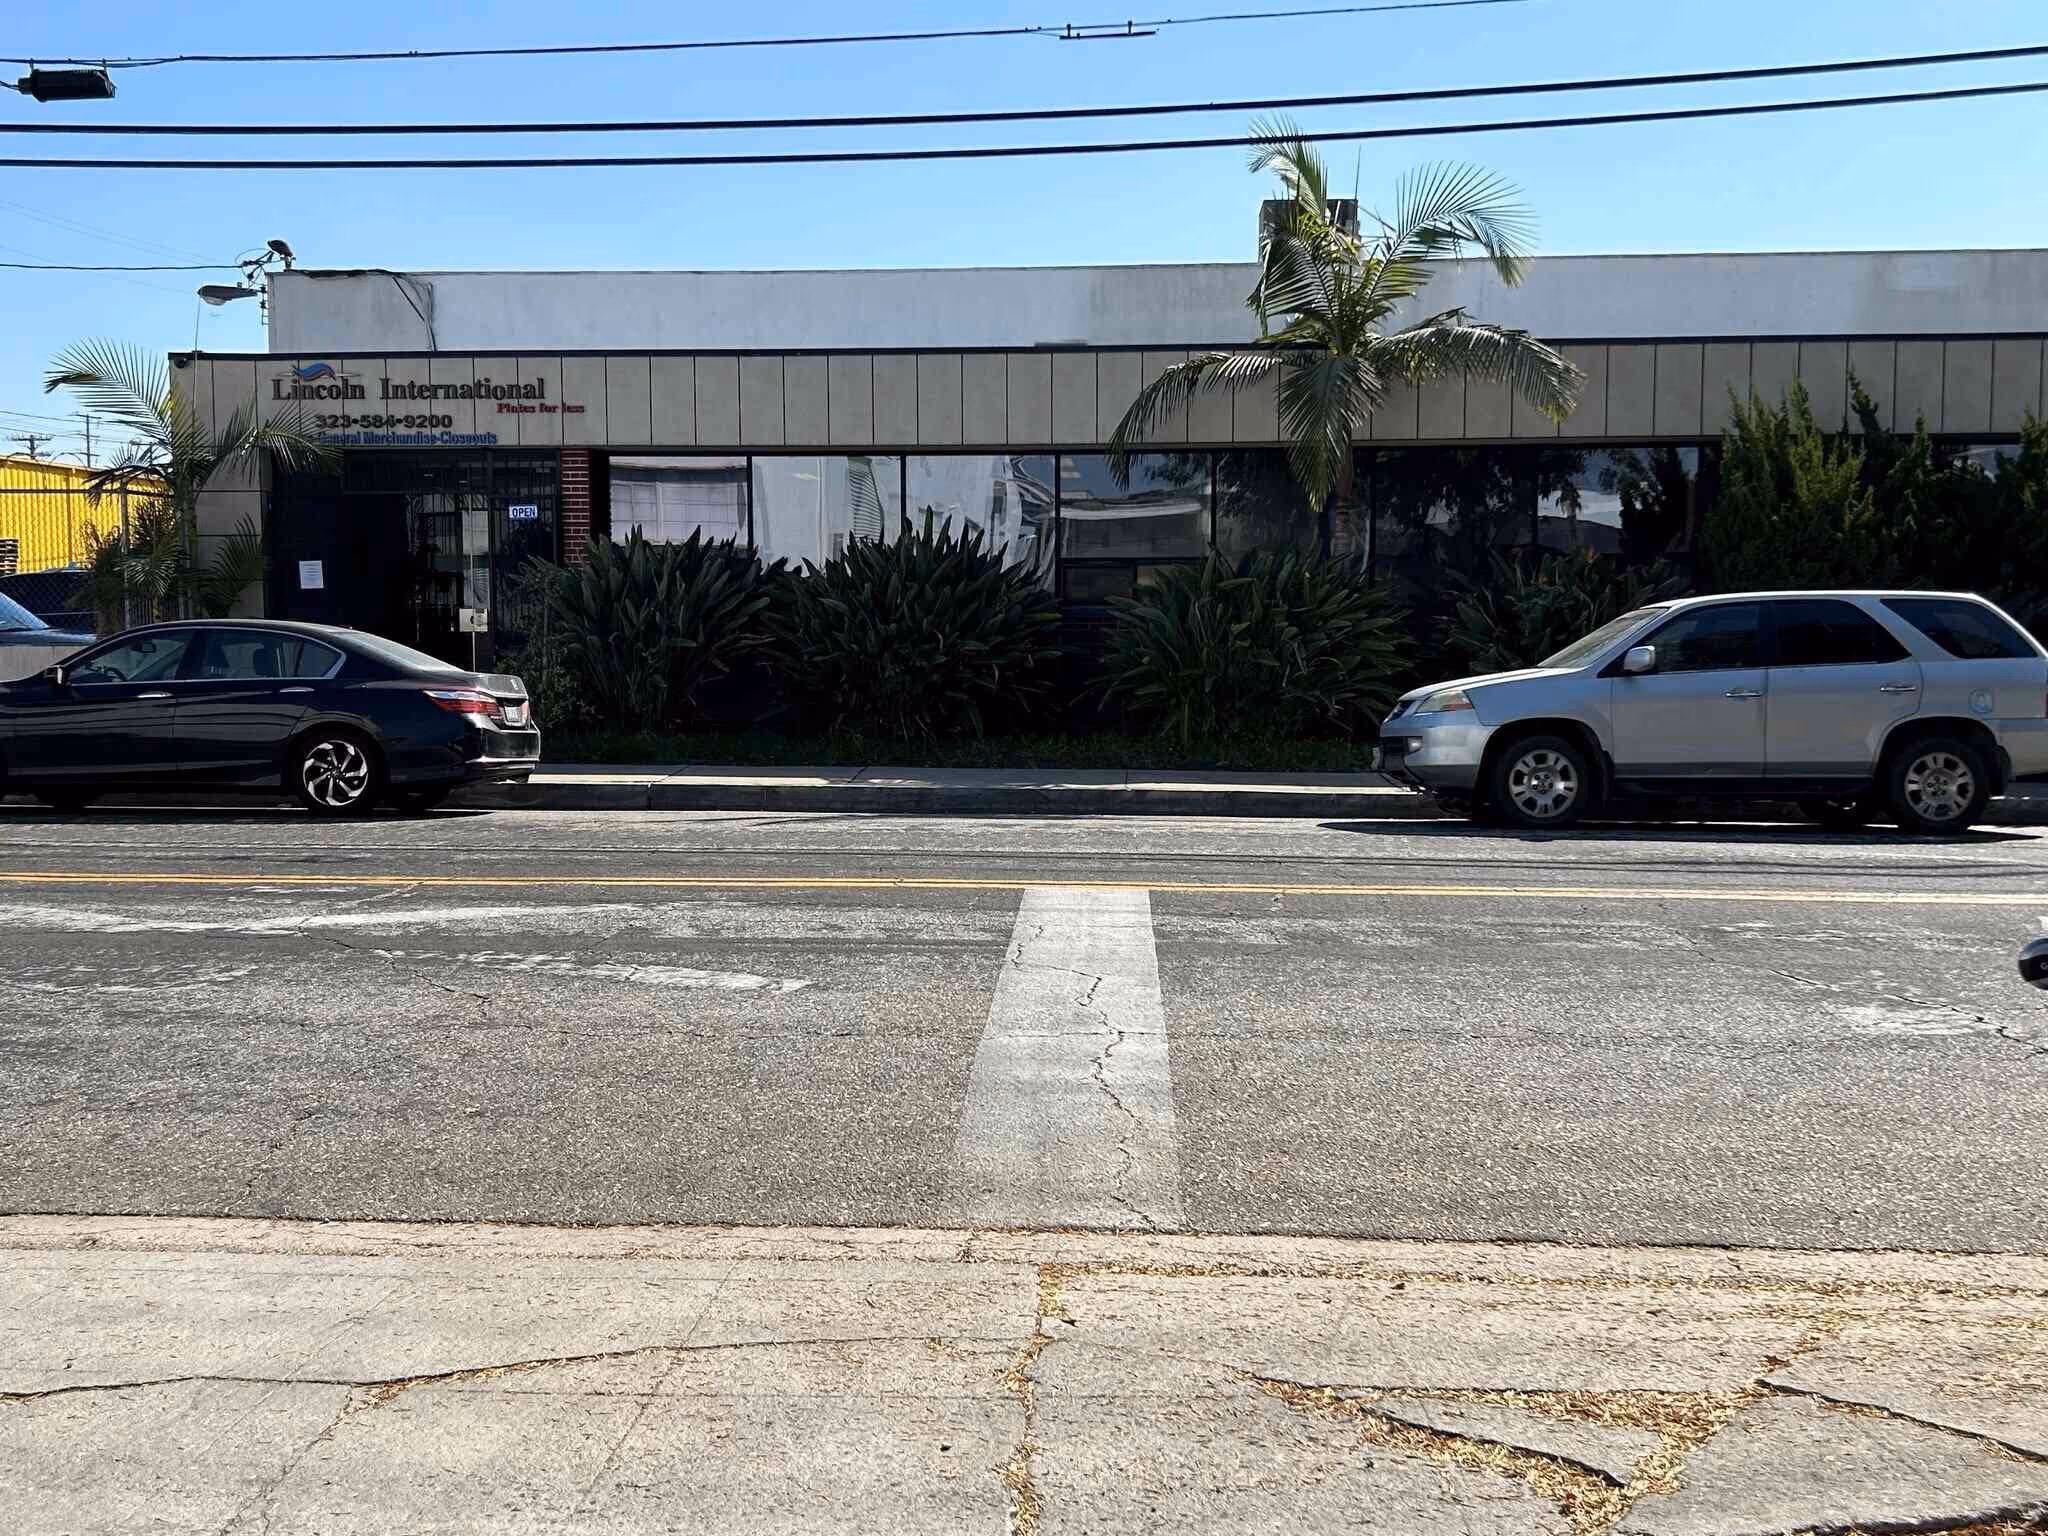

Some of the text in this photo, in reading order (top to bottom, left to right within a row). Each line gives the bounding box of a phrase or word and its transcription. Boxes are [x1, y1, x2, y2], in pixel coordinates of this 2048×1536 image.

[272, 377, 545, 400] Lincoln International
[512, 507, 536, 517] OPEN
